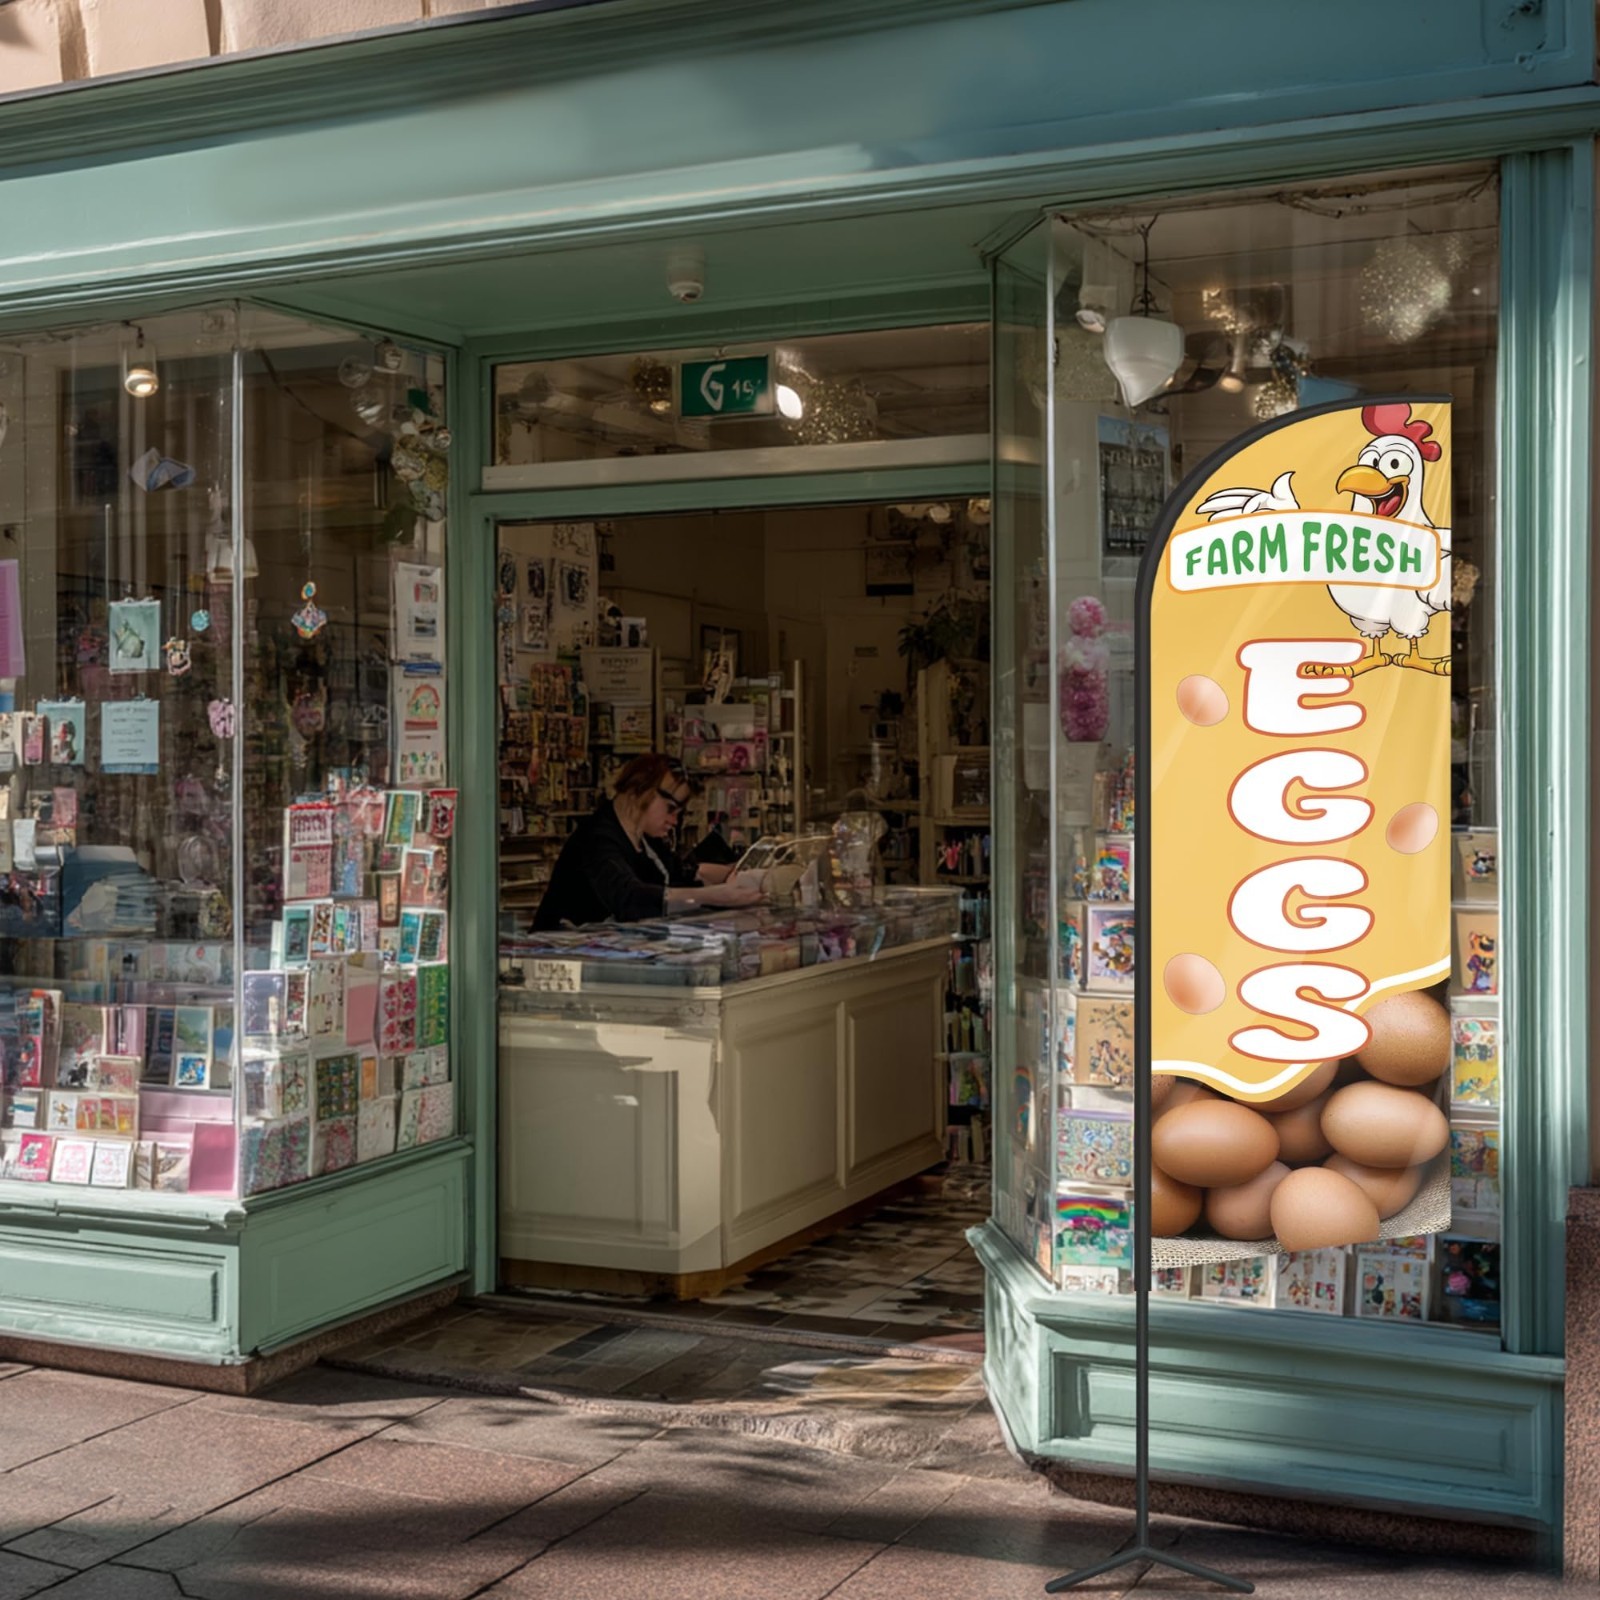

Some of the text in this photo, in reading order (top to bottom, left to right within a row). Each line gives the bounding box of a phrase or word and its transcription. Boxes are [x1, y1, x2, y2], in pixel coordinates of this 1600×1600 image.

[1186, 521, 1422, 576] FARM FRESH
[1227, 637, 1375, 1064] EGGS
